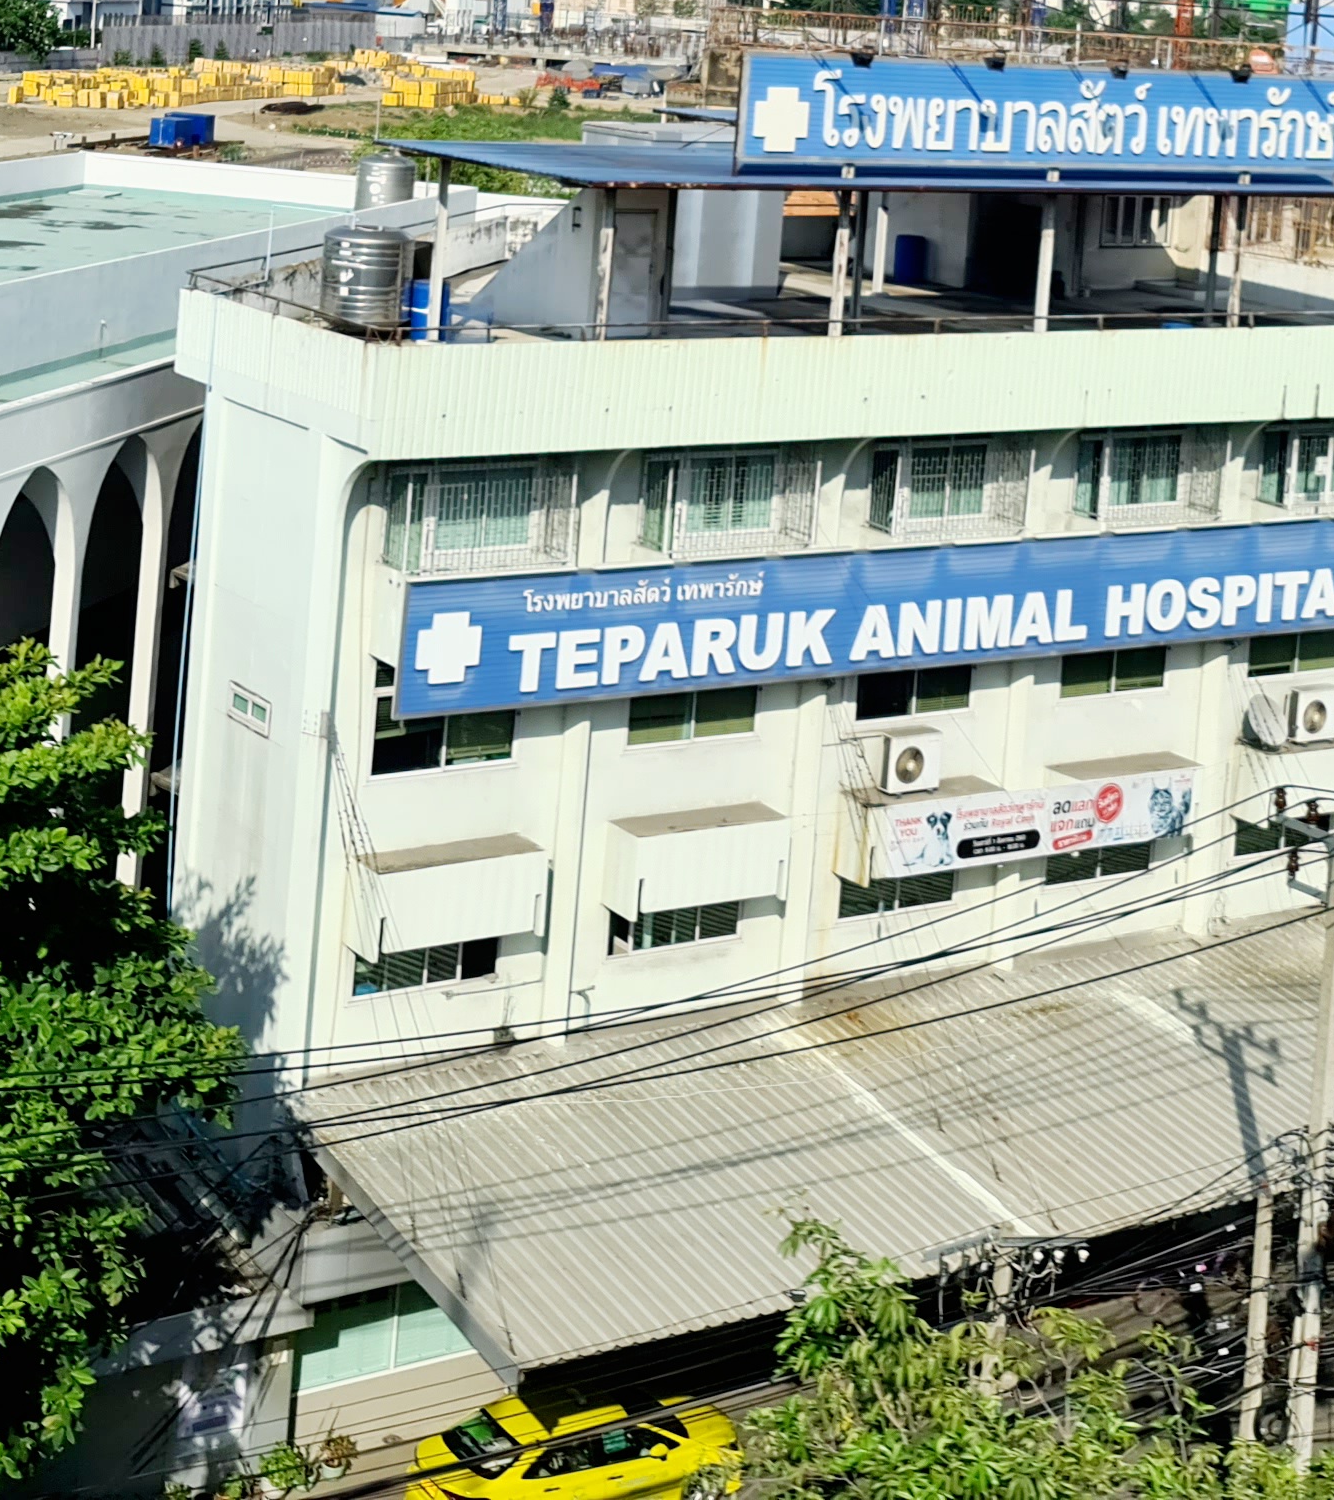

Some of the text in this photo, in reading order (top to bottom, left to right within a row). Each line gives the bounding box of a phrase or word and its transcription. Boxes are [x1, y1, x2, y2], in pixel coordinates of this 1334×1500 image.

[813, 69, 1152, 156] โรงพยาบาลสัตว์
[523, 571, 765, 613] โรงพยาบาลสัตว์ เทพารักษ์
[508, 608, 837, 693] TEPARUK
[849, 589, 1088, 662] ANIMAL
[900, 828, 918, 837] YOU
